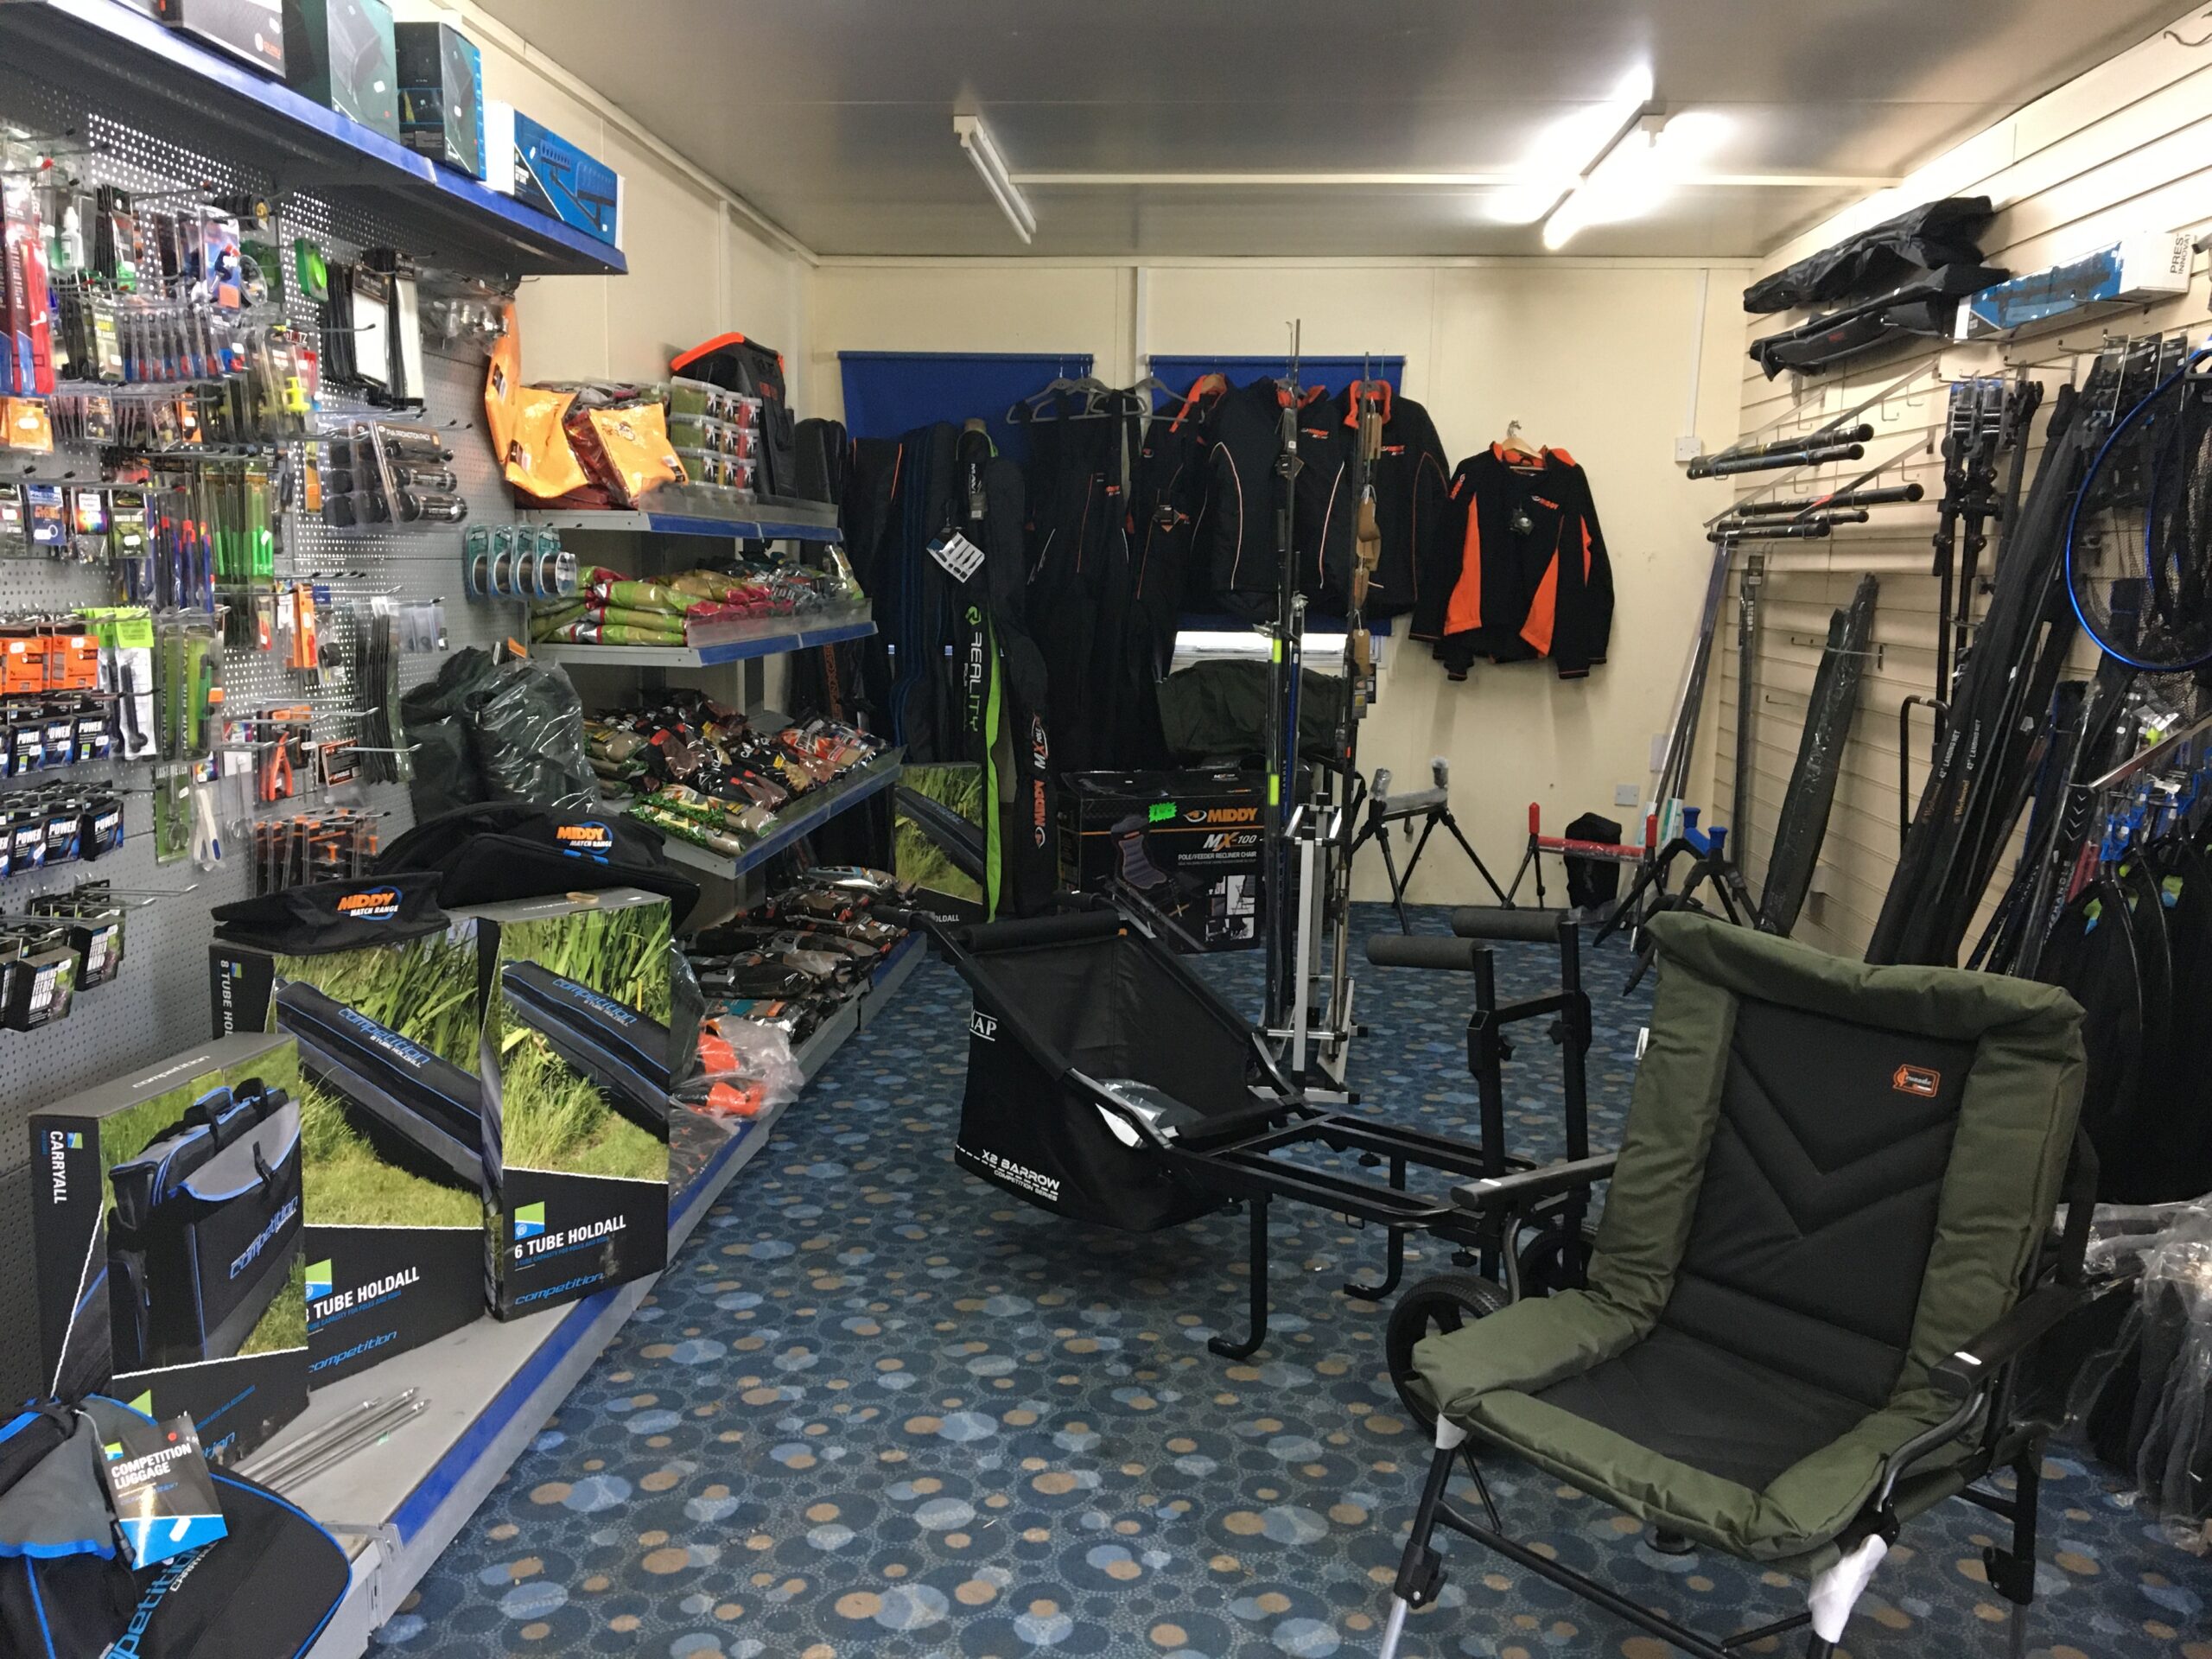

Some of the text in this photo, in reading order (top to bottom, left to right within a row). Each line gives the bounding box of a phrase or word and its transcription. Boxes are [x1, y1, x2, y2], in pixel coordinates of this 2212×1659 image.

[2170, 233, 2184, 274] PRES
[969, 632, 982, 732] REALITY
[17, 731, 39, 744] POWER
[48, 726, 71, 739] POWER
[79, 721, 102, 733] POWER
[1943, 741, 1956, 766] LANDING
[49, 820, 77, 836] POWER
[95, 812, 118, 835] POWER
[1207, 808, 1258, 823] MIDDY
[16, 829, 41, 845] POWER
[556, 827, 604, 840] MIDDY
[337, 893, 396, 912] MIDDY
[350, 905, 398, 917] MATCH RANGE
[221, 972, 232, 1008] TUBE
[553, 978, 637, 1023] competition
[338, 1007, 430, 1064] competition
[132, 1056, 211, 1088] competition
[391, 1047, 421, 1068] HOLDALL
[49, 1131, 67, 1205] CARRYALL
[982, 1148, 1060, 1191] X2 BARROW
[994, 1169, 1058, 1202] COMPETITION SERIES
[230, 1196, 298, 1280] competition
[514, 1214, 626, 1259] 6 TUBE HOLDALL
[314, 1291, 353, 1319] TUBE
[357, 1267, 420, 1303] HOLDALL
[515, 1272, 605, 1306] competition
[111, 1442, 192, 1477] COMPETITION
[115, 1461, 171, 1490] LUGGAGE
